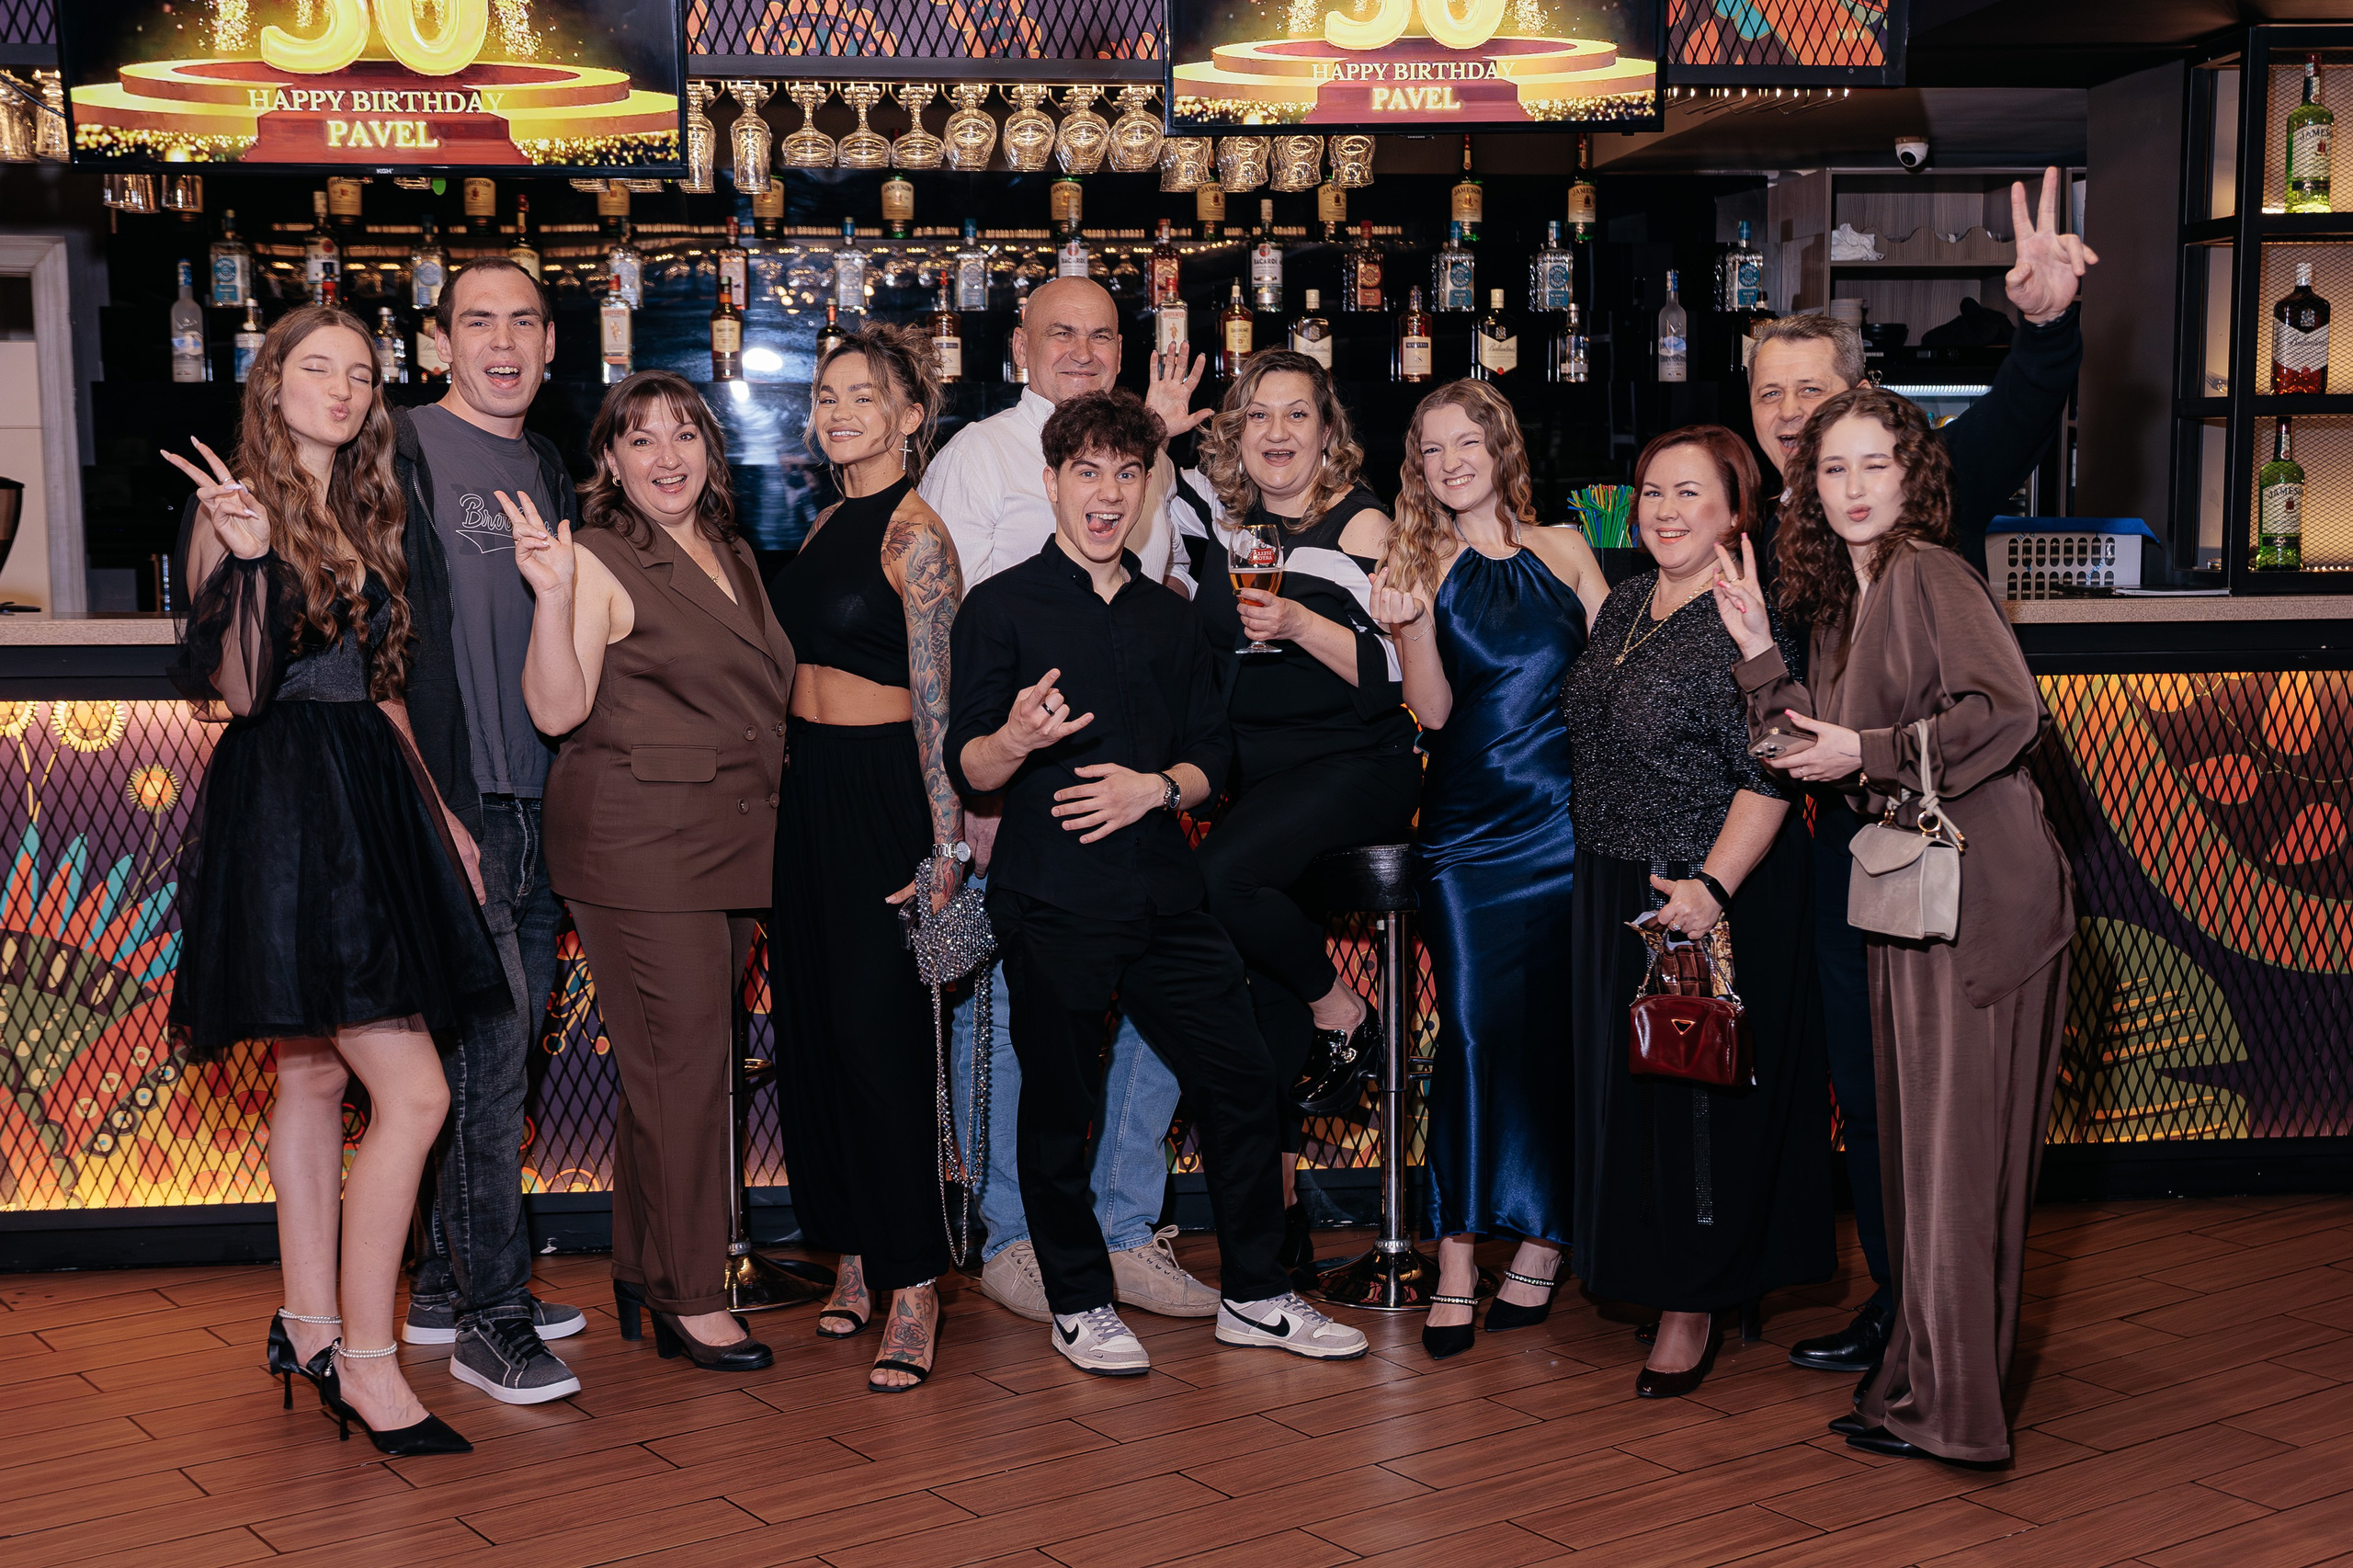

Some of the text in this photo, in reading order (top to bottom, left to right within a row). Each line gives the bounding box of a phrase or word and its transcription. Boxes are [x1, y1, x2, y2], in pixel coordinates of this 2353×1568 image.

[1311, 62, 1516, 82] HAPPY BIRTHDAY
[247, 89, 505, 113] HAPPY BIRTHDAY
[1372, 86, 1461, 110] PAVEL
[326, 119, 439, 148] PAVEL
[2300, 128, 2334, 141] JAMESO
[1453, 187, 1482, 197] JAMESON
[2268, 486, 2304, 499] JAMESO
